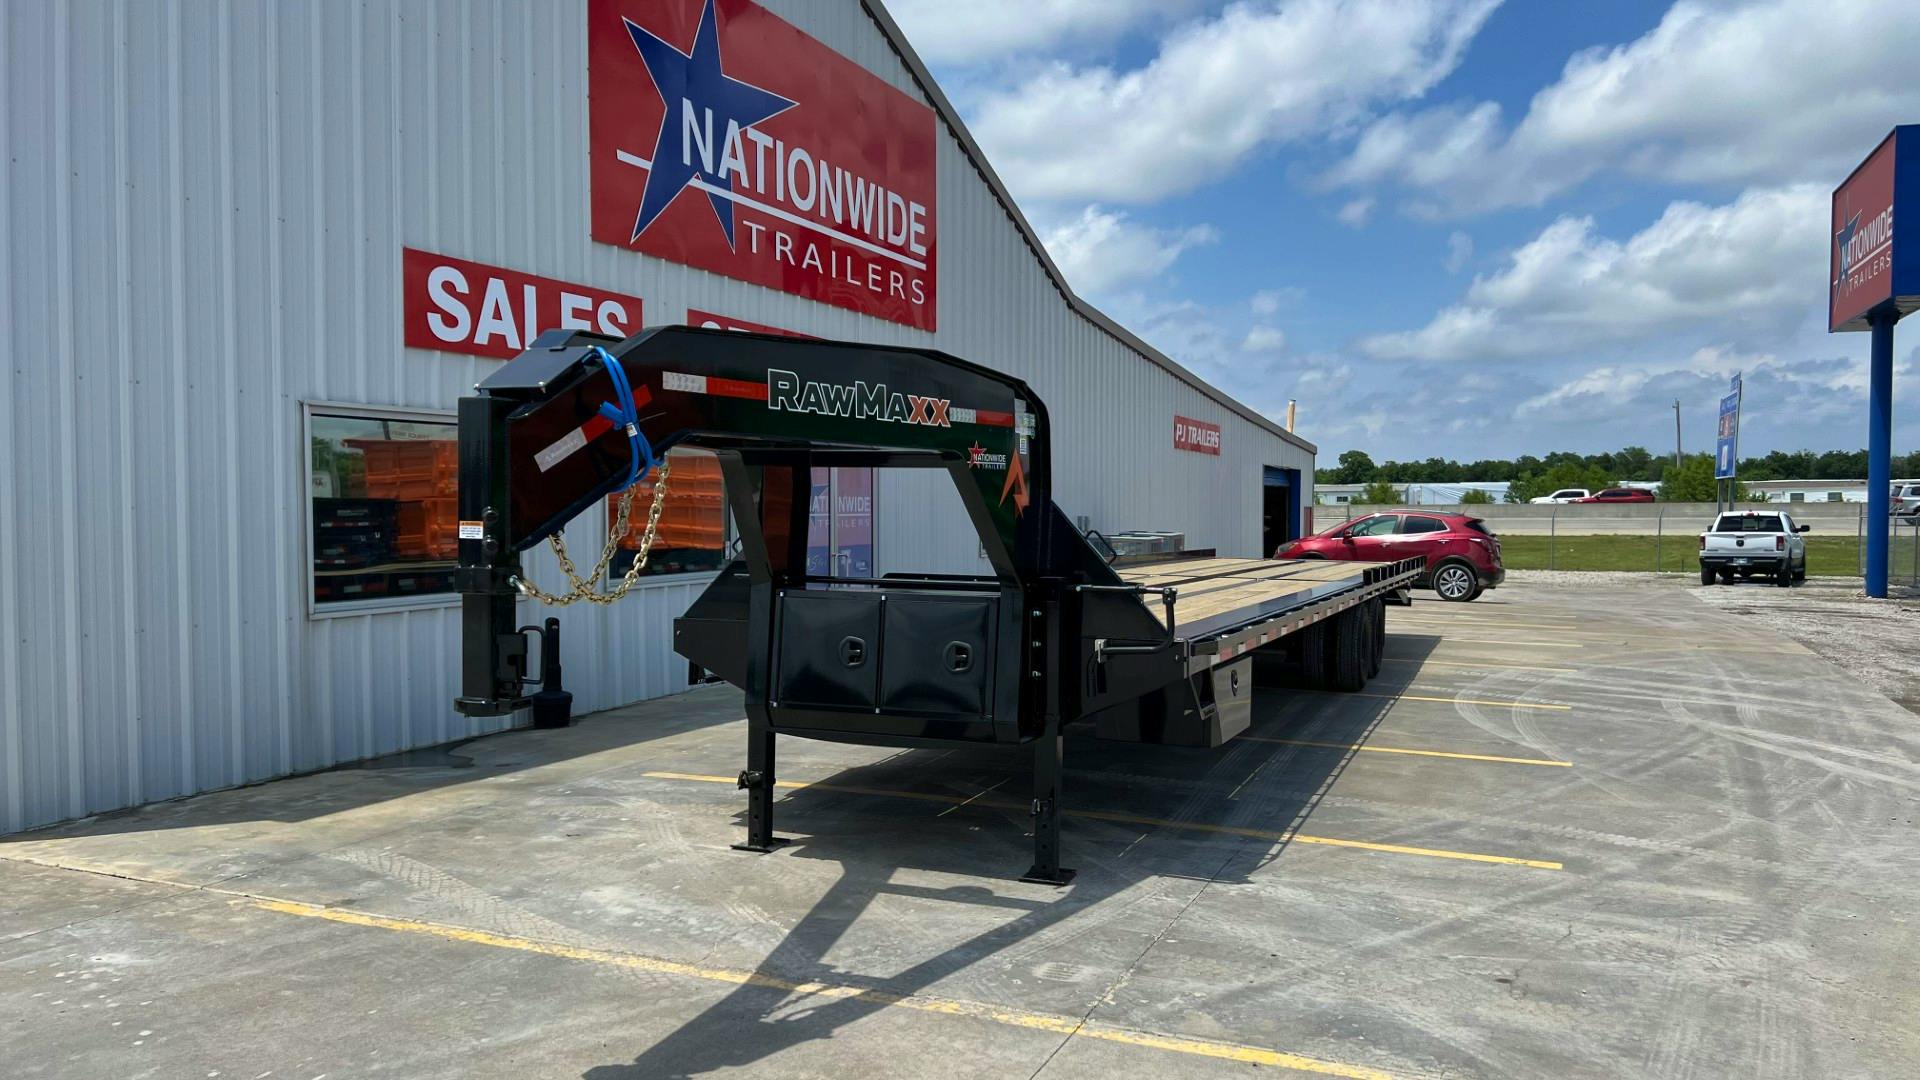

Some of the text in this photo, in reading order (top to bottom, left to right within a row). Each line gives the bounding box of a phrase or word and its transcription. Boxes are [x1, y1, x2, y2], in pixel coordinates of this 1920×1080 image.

[682, 97, 927, 257] NATIONWIDE
[742, 219, 925, 305] TRAILERS
[1841, 204, 1893, 274] NATIONWIDE
[1849, 251, 1892, 292] TRAILERS
[973, 453, 1007, 462] NATIONWIDE
[1176, 423, 1220, 448] PJ TRAILERS
